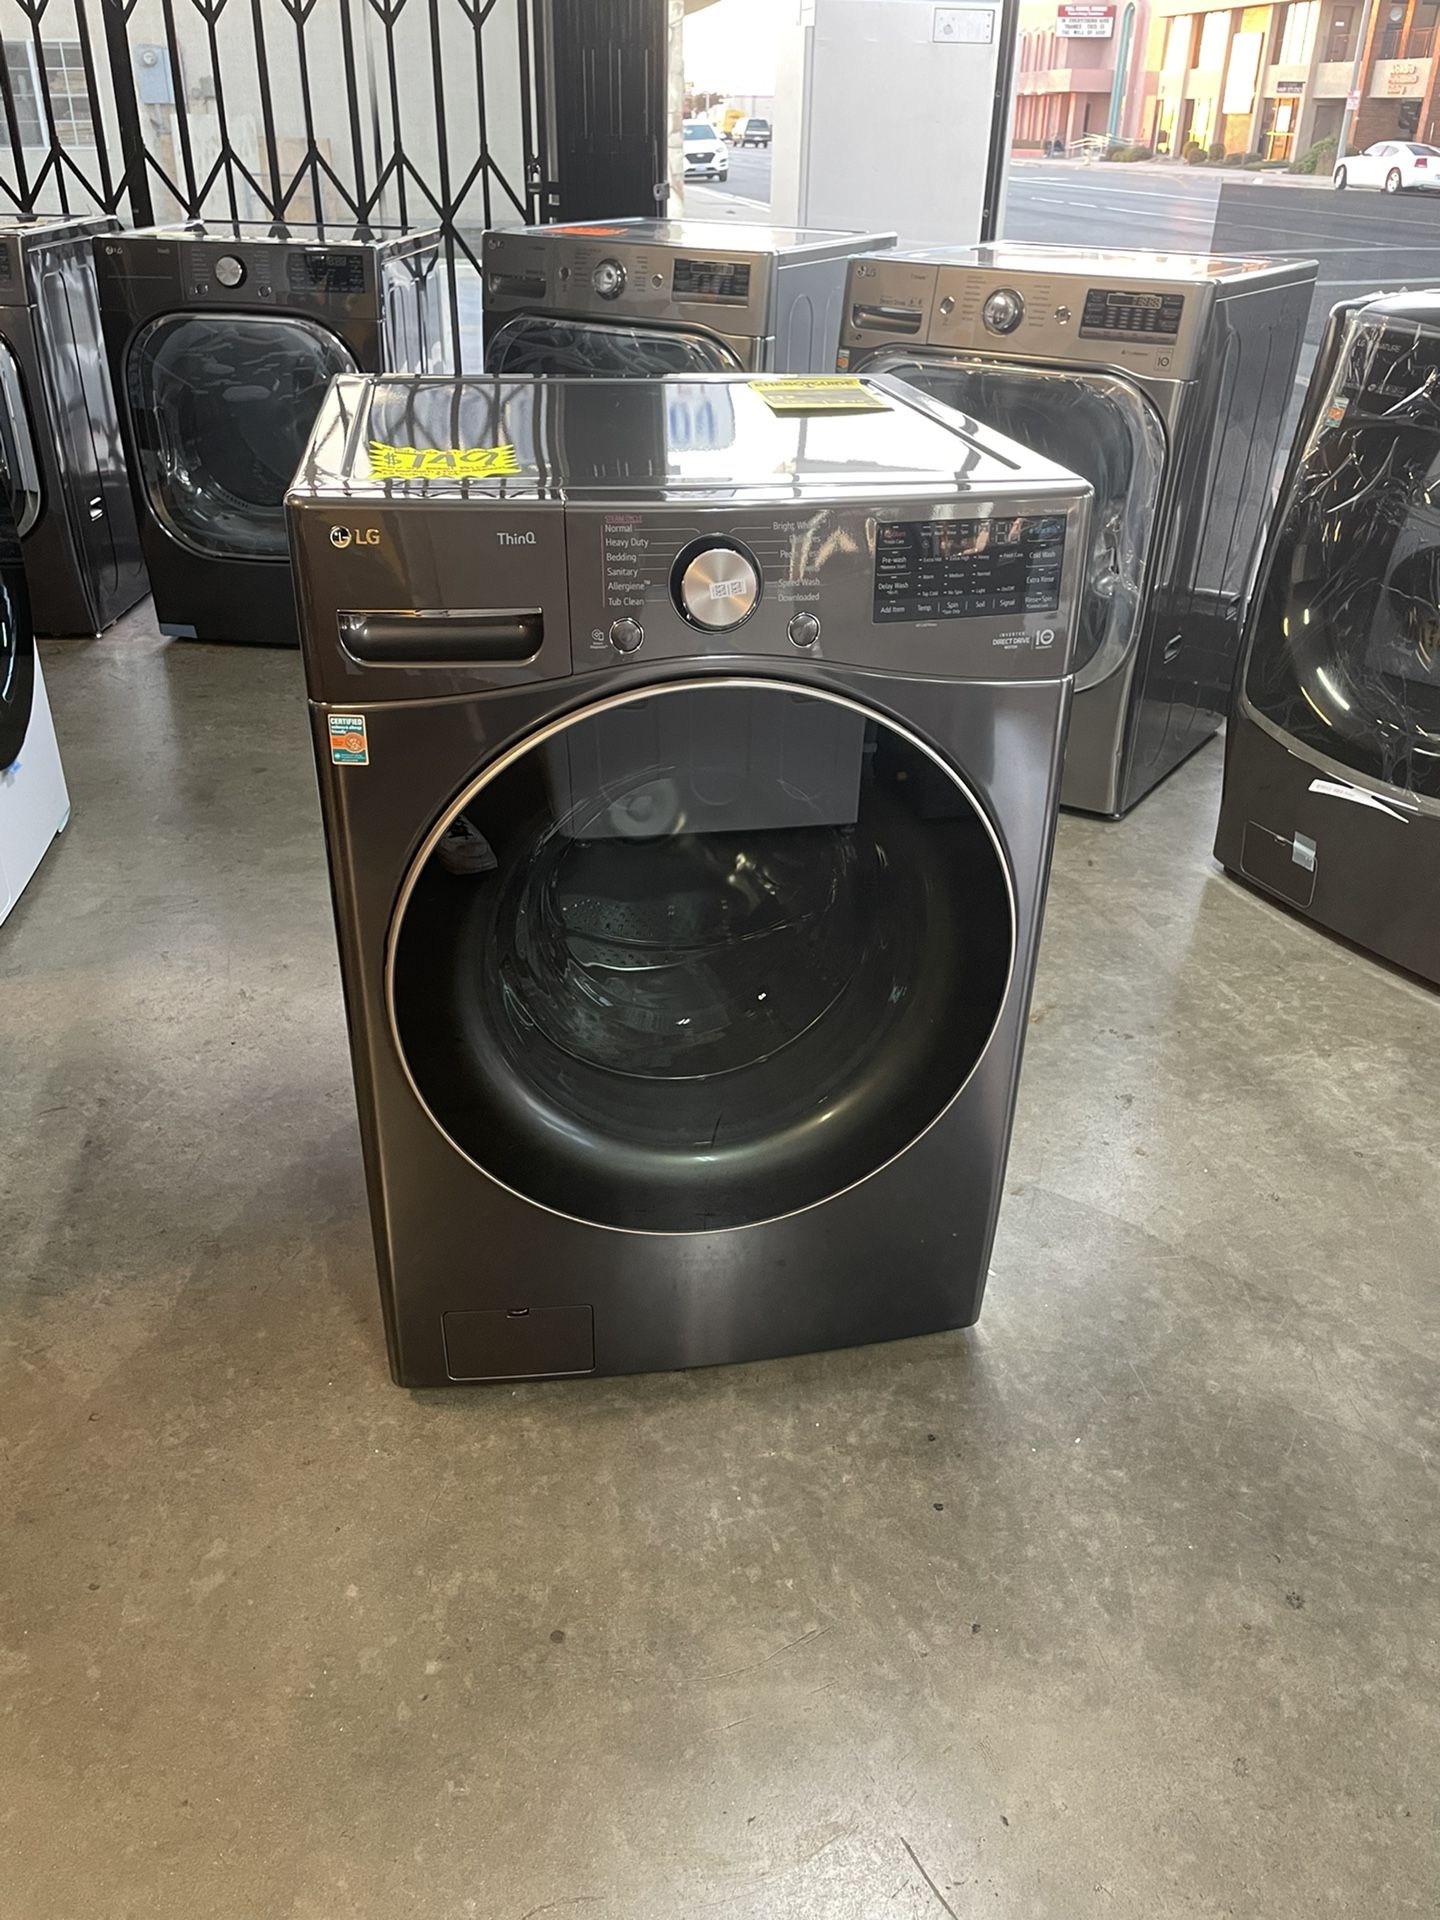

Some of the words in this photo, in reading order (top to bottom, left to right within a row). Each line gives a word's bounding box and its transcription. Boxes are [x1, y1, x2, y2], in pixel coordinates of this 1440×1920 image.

[605, 525, 632, 533] Normal
[355, 528, 380, 545] LG
[497, 532, 536, 545] ThinQ
[605, 539, 629, 548] Heavy
[630, 539, 649, 548] Duty
[606, 552, 637, 562] Bedding
[607, 568, 638, 577] Sanitary
[878, 582, 893, 590] Delay
[778, 592, 819, 601] Downloaded
[608, 597, 621, 606] Tub
[623, 597, 644, 606] Clean
[1000, 600, 1015, 608] Signal
[891, 605, 905, 613] Item
[1036, 629, 1055, 645] 10
[992, 638, 1012, 646] DIRECT
